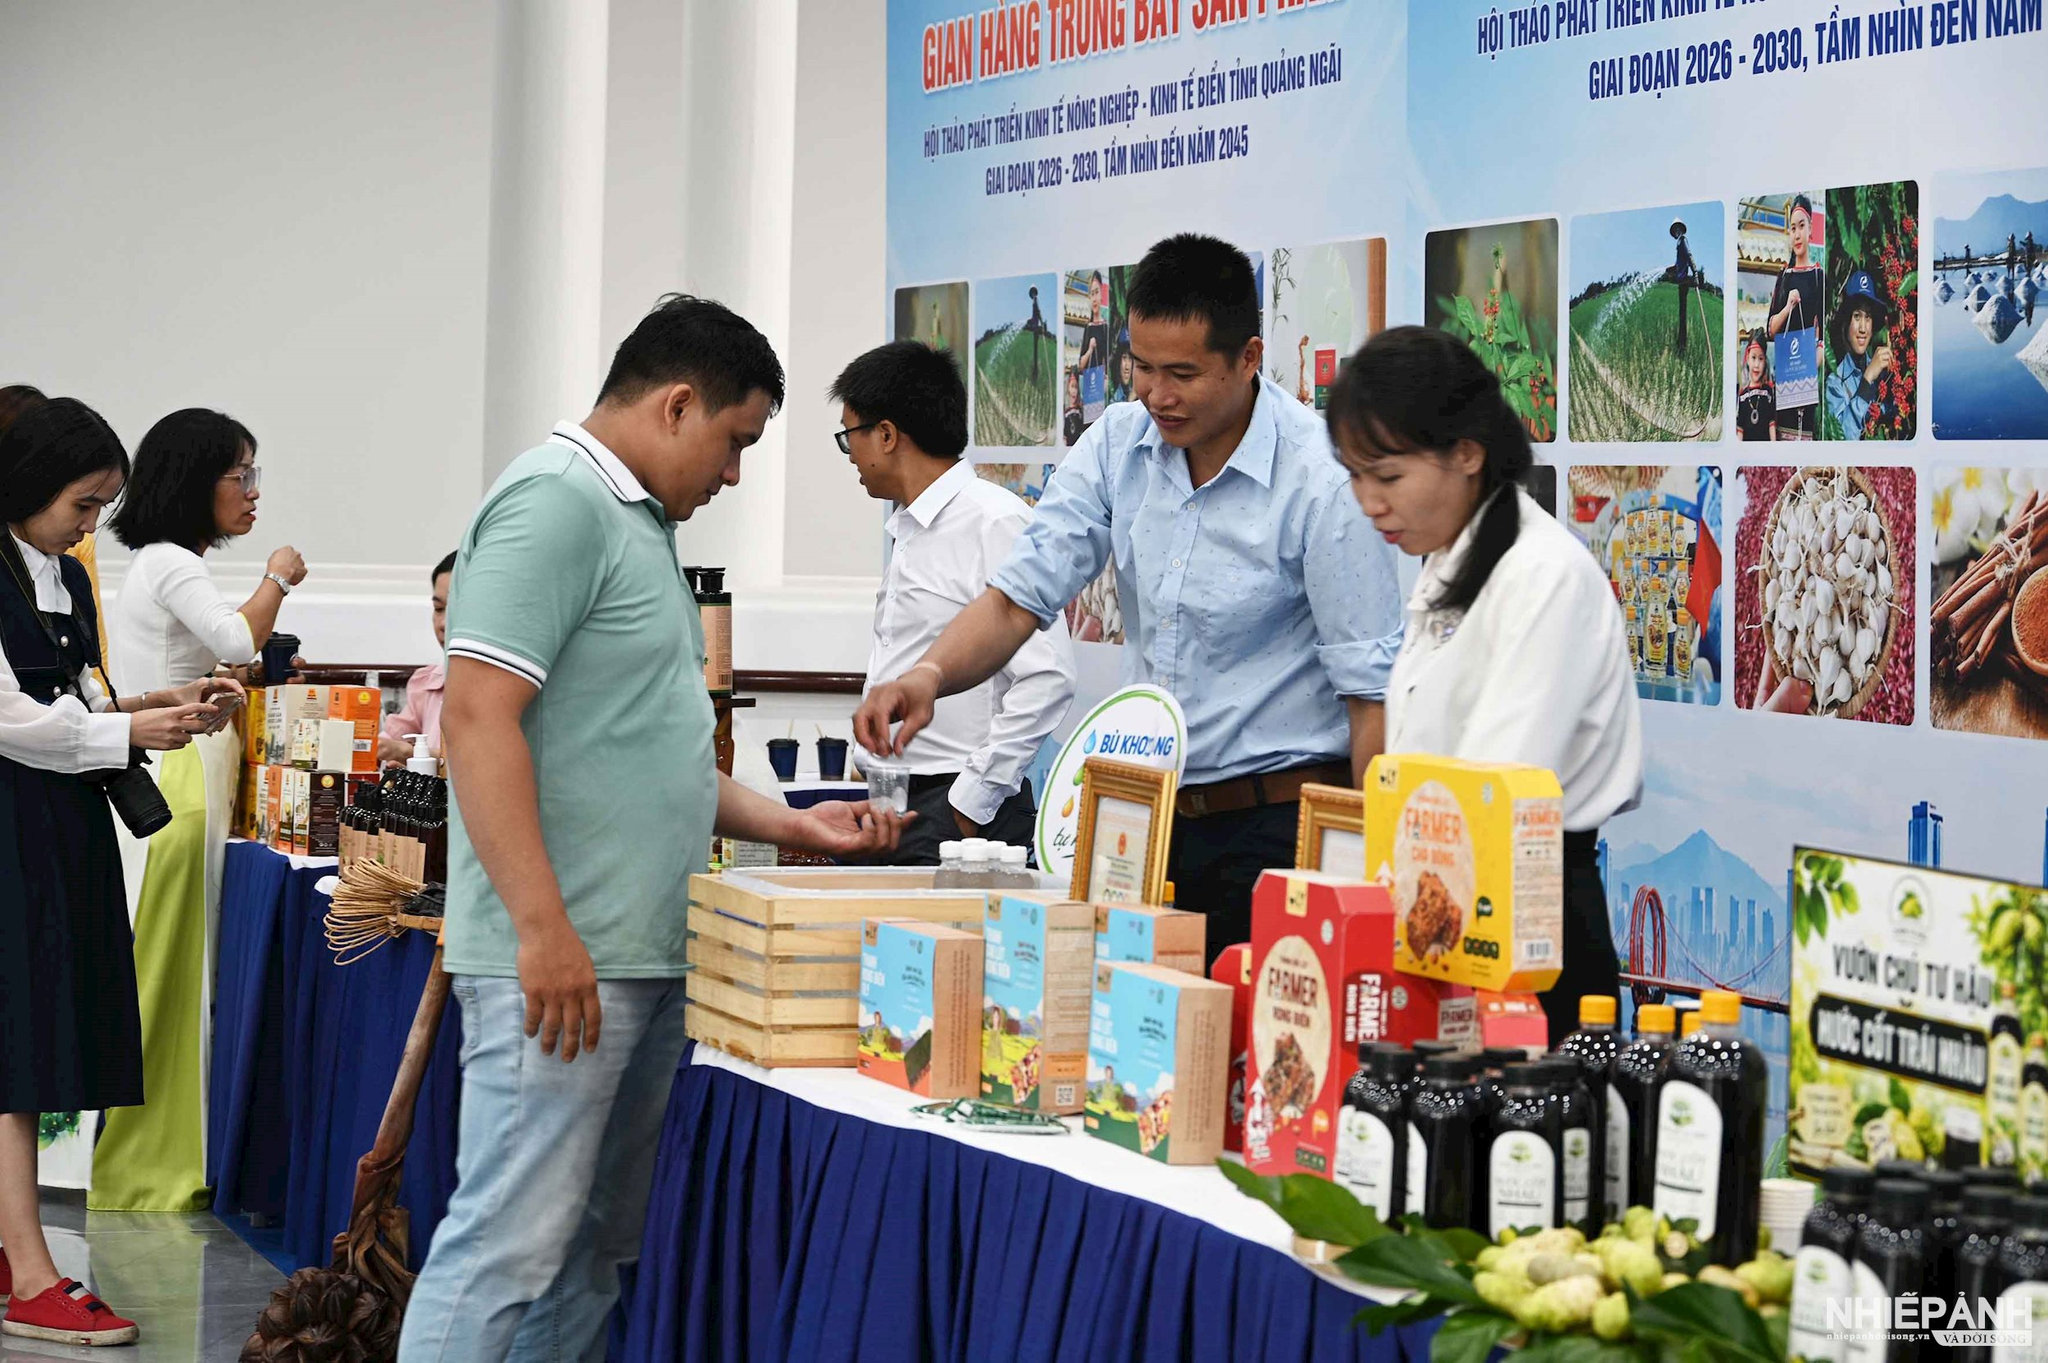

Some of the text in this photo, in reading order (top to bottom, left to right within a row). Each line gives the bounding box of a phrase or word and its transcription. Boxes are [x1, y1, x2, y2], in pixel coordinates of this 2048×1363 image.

[923, 15, 974, 92] GIAN
[1478, 7, 1504, 60] HỘI
[1589, 57, 1624, 101] GIAI
[1629, 47, 1680, 99] ĐOẠN
[1685, 39, 1733, 86] 2026
[1752, 27, 1808, 75] 2030,
[1815, 5, 1861, 65] TẦM
[1868, 0, 1923, 57] NHÌN
[924, 124, 939, 163] HỘI
[942, 116, 965, 155] THẢO
[967, 113, 992, 150] PHÁT
[994, 101, 1022, 145] TRIỂN
[1025, 107, 1049, 140] KINH
[1052, 94, 1065, 135] TẾ
[1067, 94, 1096, 132] NÔNG
[1099, 84, 1139, 129] NGHIỆP
[1150, 82, 1177, 117] KINH
[1181, 67, 1195, 111] TẾ
[1198, 60, 1225, 108] BIỂN
[1229, 57, 1257, 102] TỈNH
[1261, 48, 1305, 99] QUẢNG
[1309, 42, 1342, 87] NGÃI
[986, 165, 1005, 196] GIAI
[1007, 161, 1035, 197] ĐOẠN
[1037, 156, 1062, 189] 2026
[1072, 150, 1101, 184] 2030,
[1104, 135, 1127, 178] TẦM
[1130, 134, 1158, 175] NHÌN
[1161, 126, 1184, 170] ĐẾN
[1188, 124, 1215, 165] NĂM
[1219, 124, 1249, 160] 2045
[1406, 807, 1461, 846] FARMER
[1268, 967, 1318, 1009] FARMER
[1359, 974, 1382, 1043] FARME
